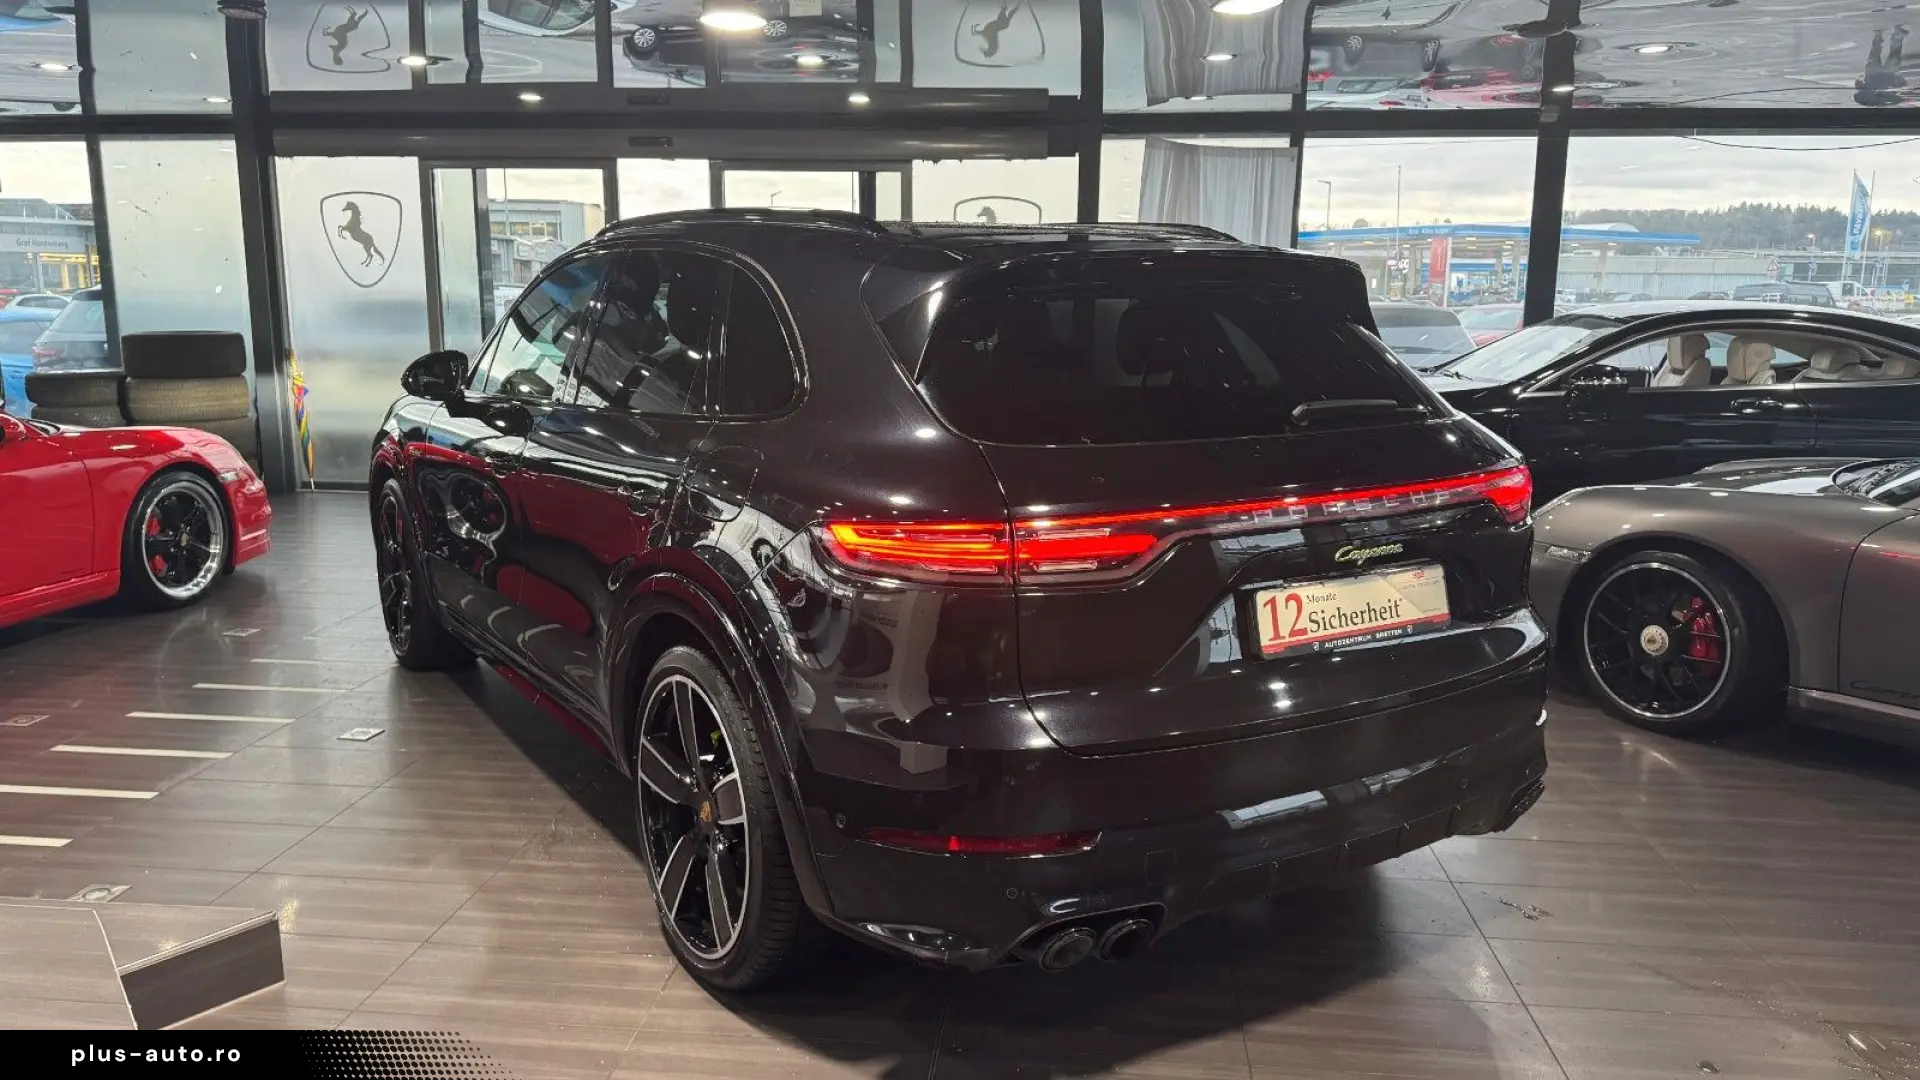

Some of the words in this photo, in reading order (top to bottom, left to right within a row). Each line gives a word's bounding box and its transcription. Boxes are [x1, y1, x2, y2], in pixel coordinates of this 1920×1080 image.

[1335, 543, 1403, 565] Cayenne
[1306, 592, 1338, 605] Monate
[1263, 592, 1309, 642] 12
[1308, 598, 1401, 633] Sicherheit
[1324, 633, 1372, 649] AUTOZENTRUM
[1375, 628, 1403, 640] BRETTEN
